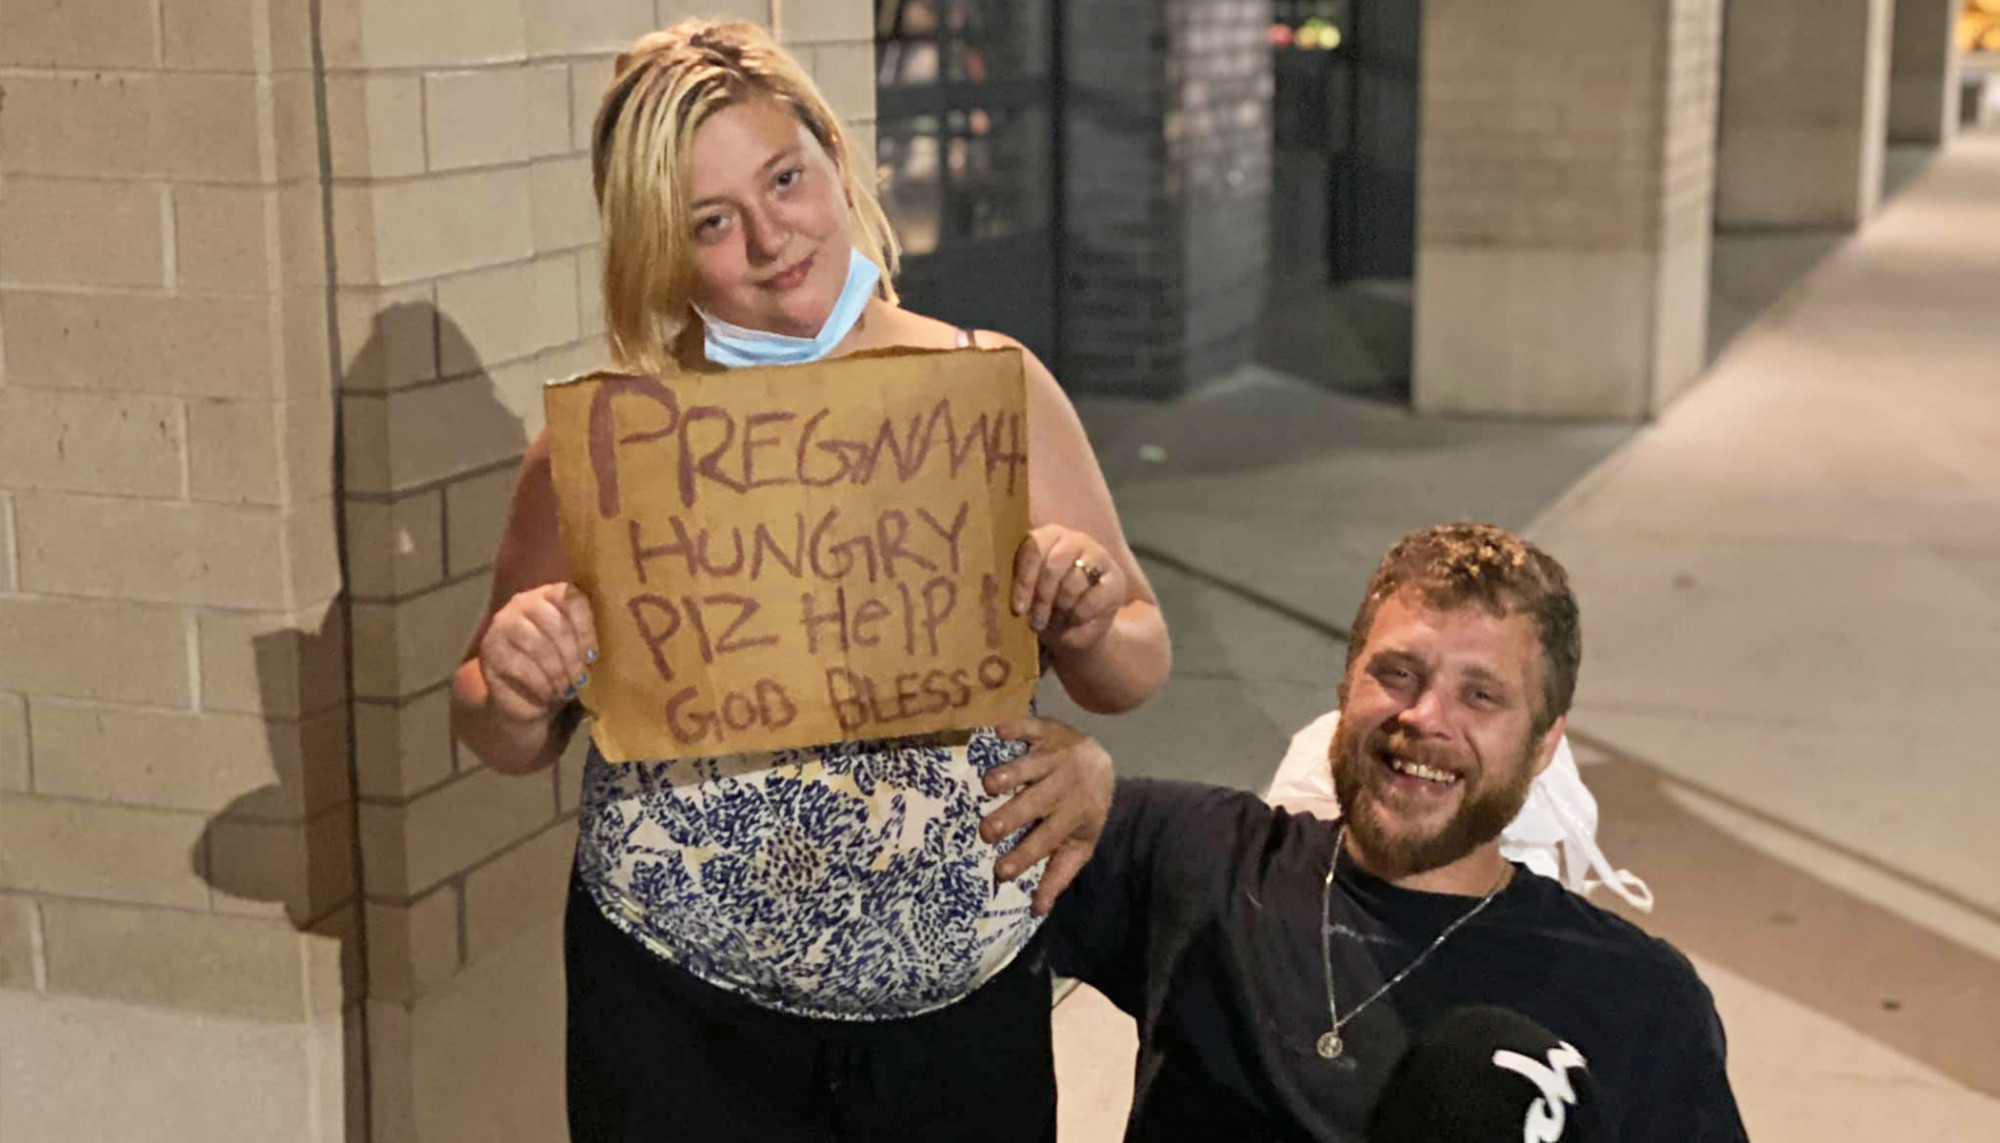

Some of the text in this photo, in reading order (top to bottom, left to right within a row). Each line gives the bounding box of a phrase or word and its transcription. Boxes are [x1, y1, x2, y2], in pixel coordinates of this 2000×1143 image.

[629, 501, 969, 584] HUNGRY
[666, 666, 972, 745] GOD BLESS
